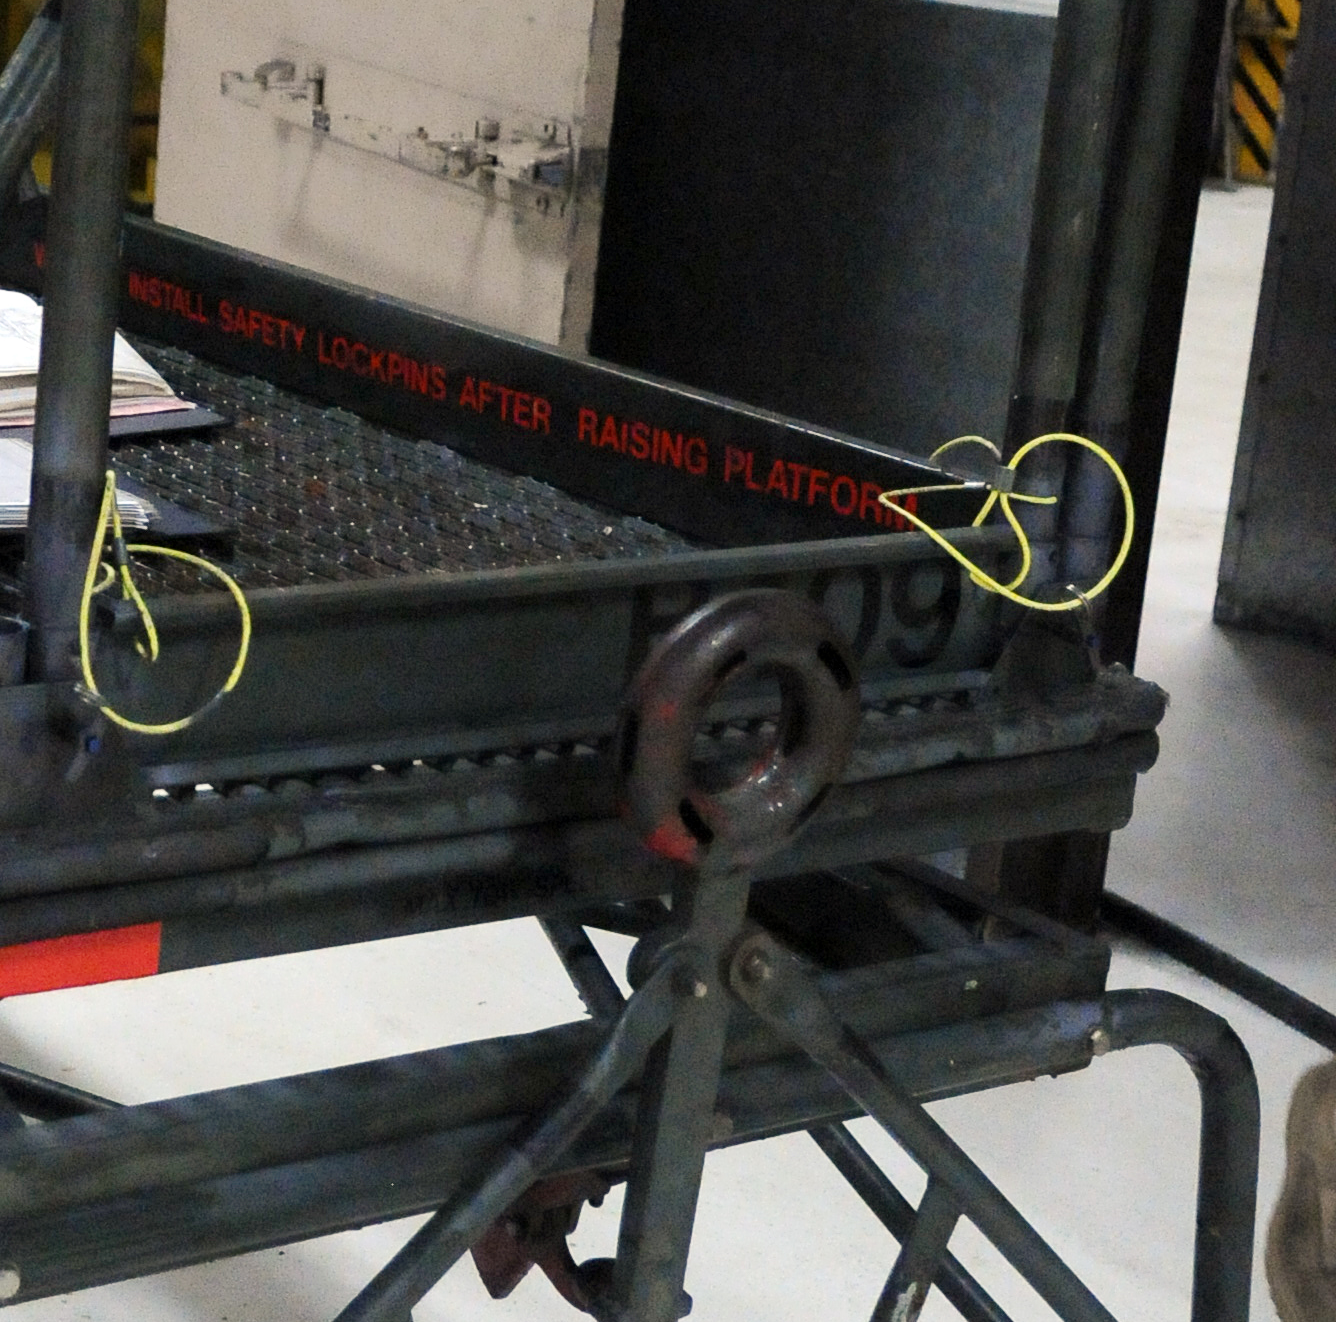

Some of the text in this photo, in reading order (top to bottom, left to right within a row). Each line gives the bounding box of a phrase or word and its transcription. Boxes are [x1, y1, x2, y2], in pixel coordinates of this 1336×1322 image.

[129, 274, 917, 530] INSTALL SAFETY LOCKPINS AFTER RAISING PLATFORM
